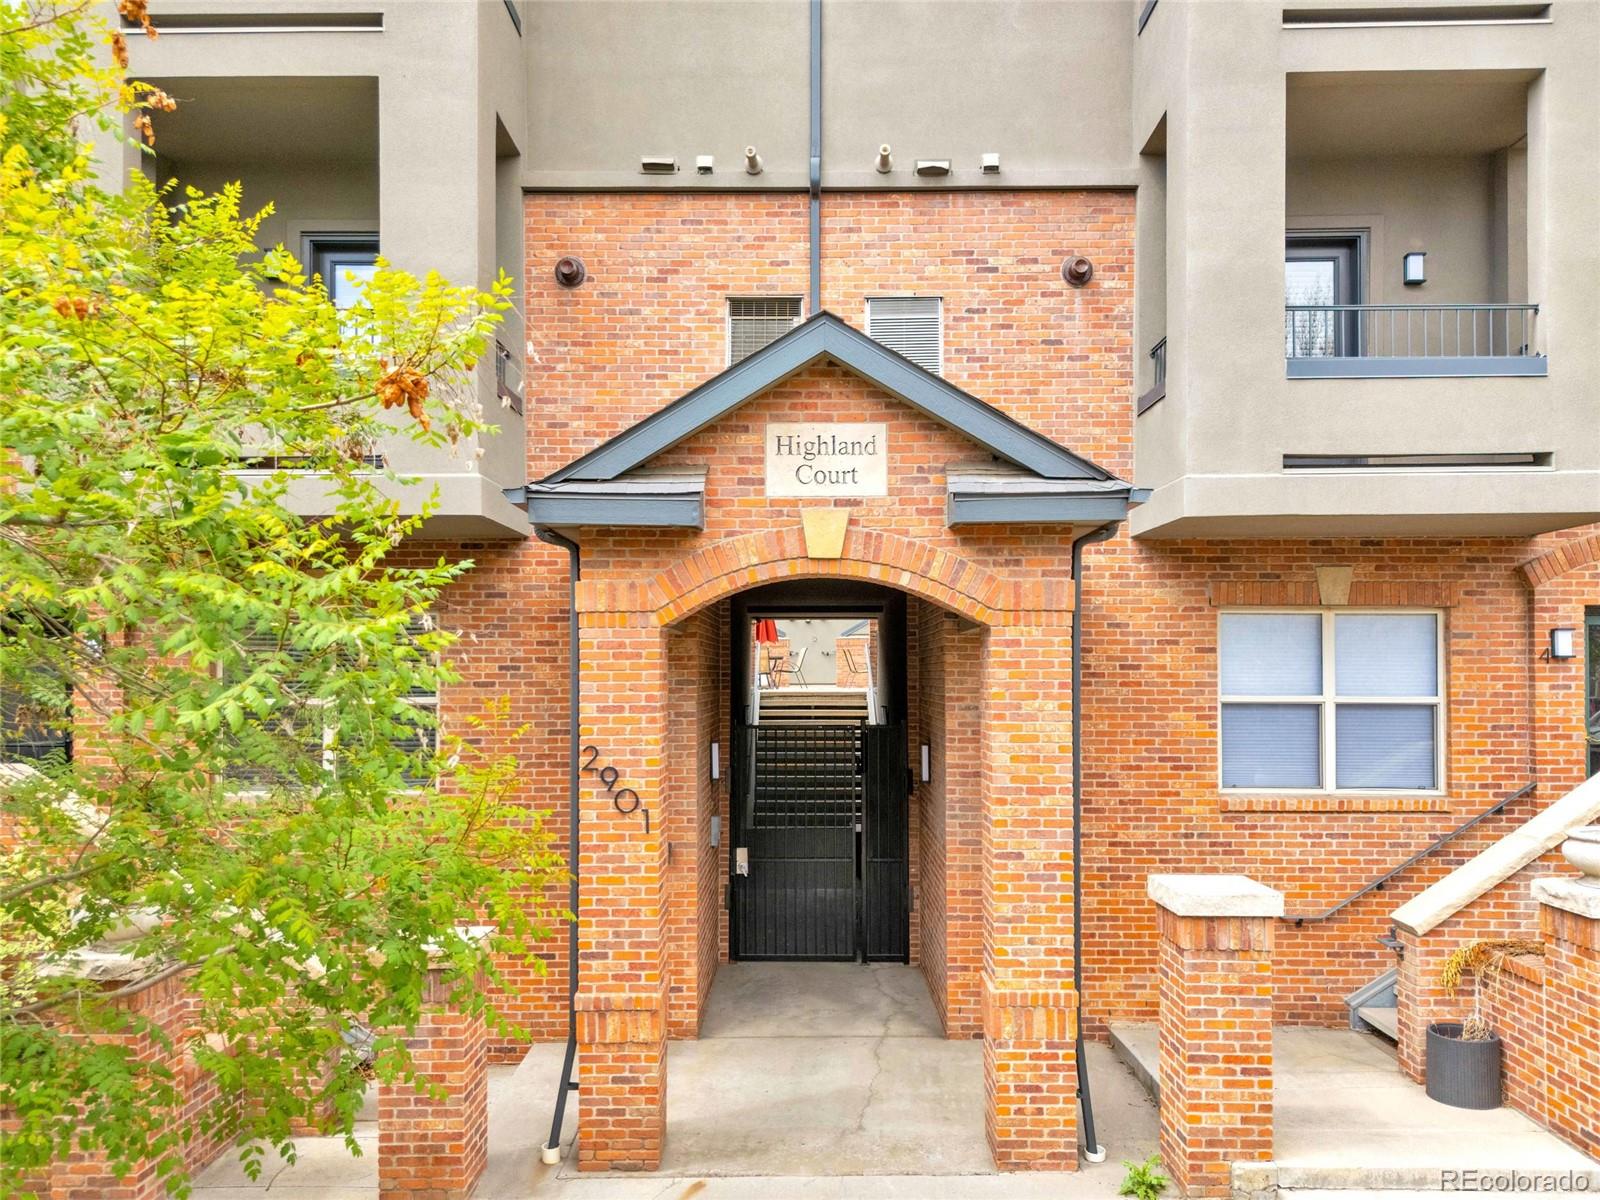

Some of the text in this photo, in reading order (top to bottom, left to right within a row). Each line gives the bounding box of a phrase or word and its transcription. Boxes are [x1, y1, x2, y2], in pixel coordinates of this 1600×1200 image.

[775, 434, 878, 461] Highland
[795, 464, 859, 485] Court
[1538, 647, 1550, 664] 4
[581, 745, 650, 834] 2901
